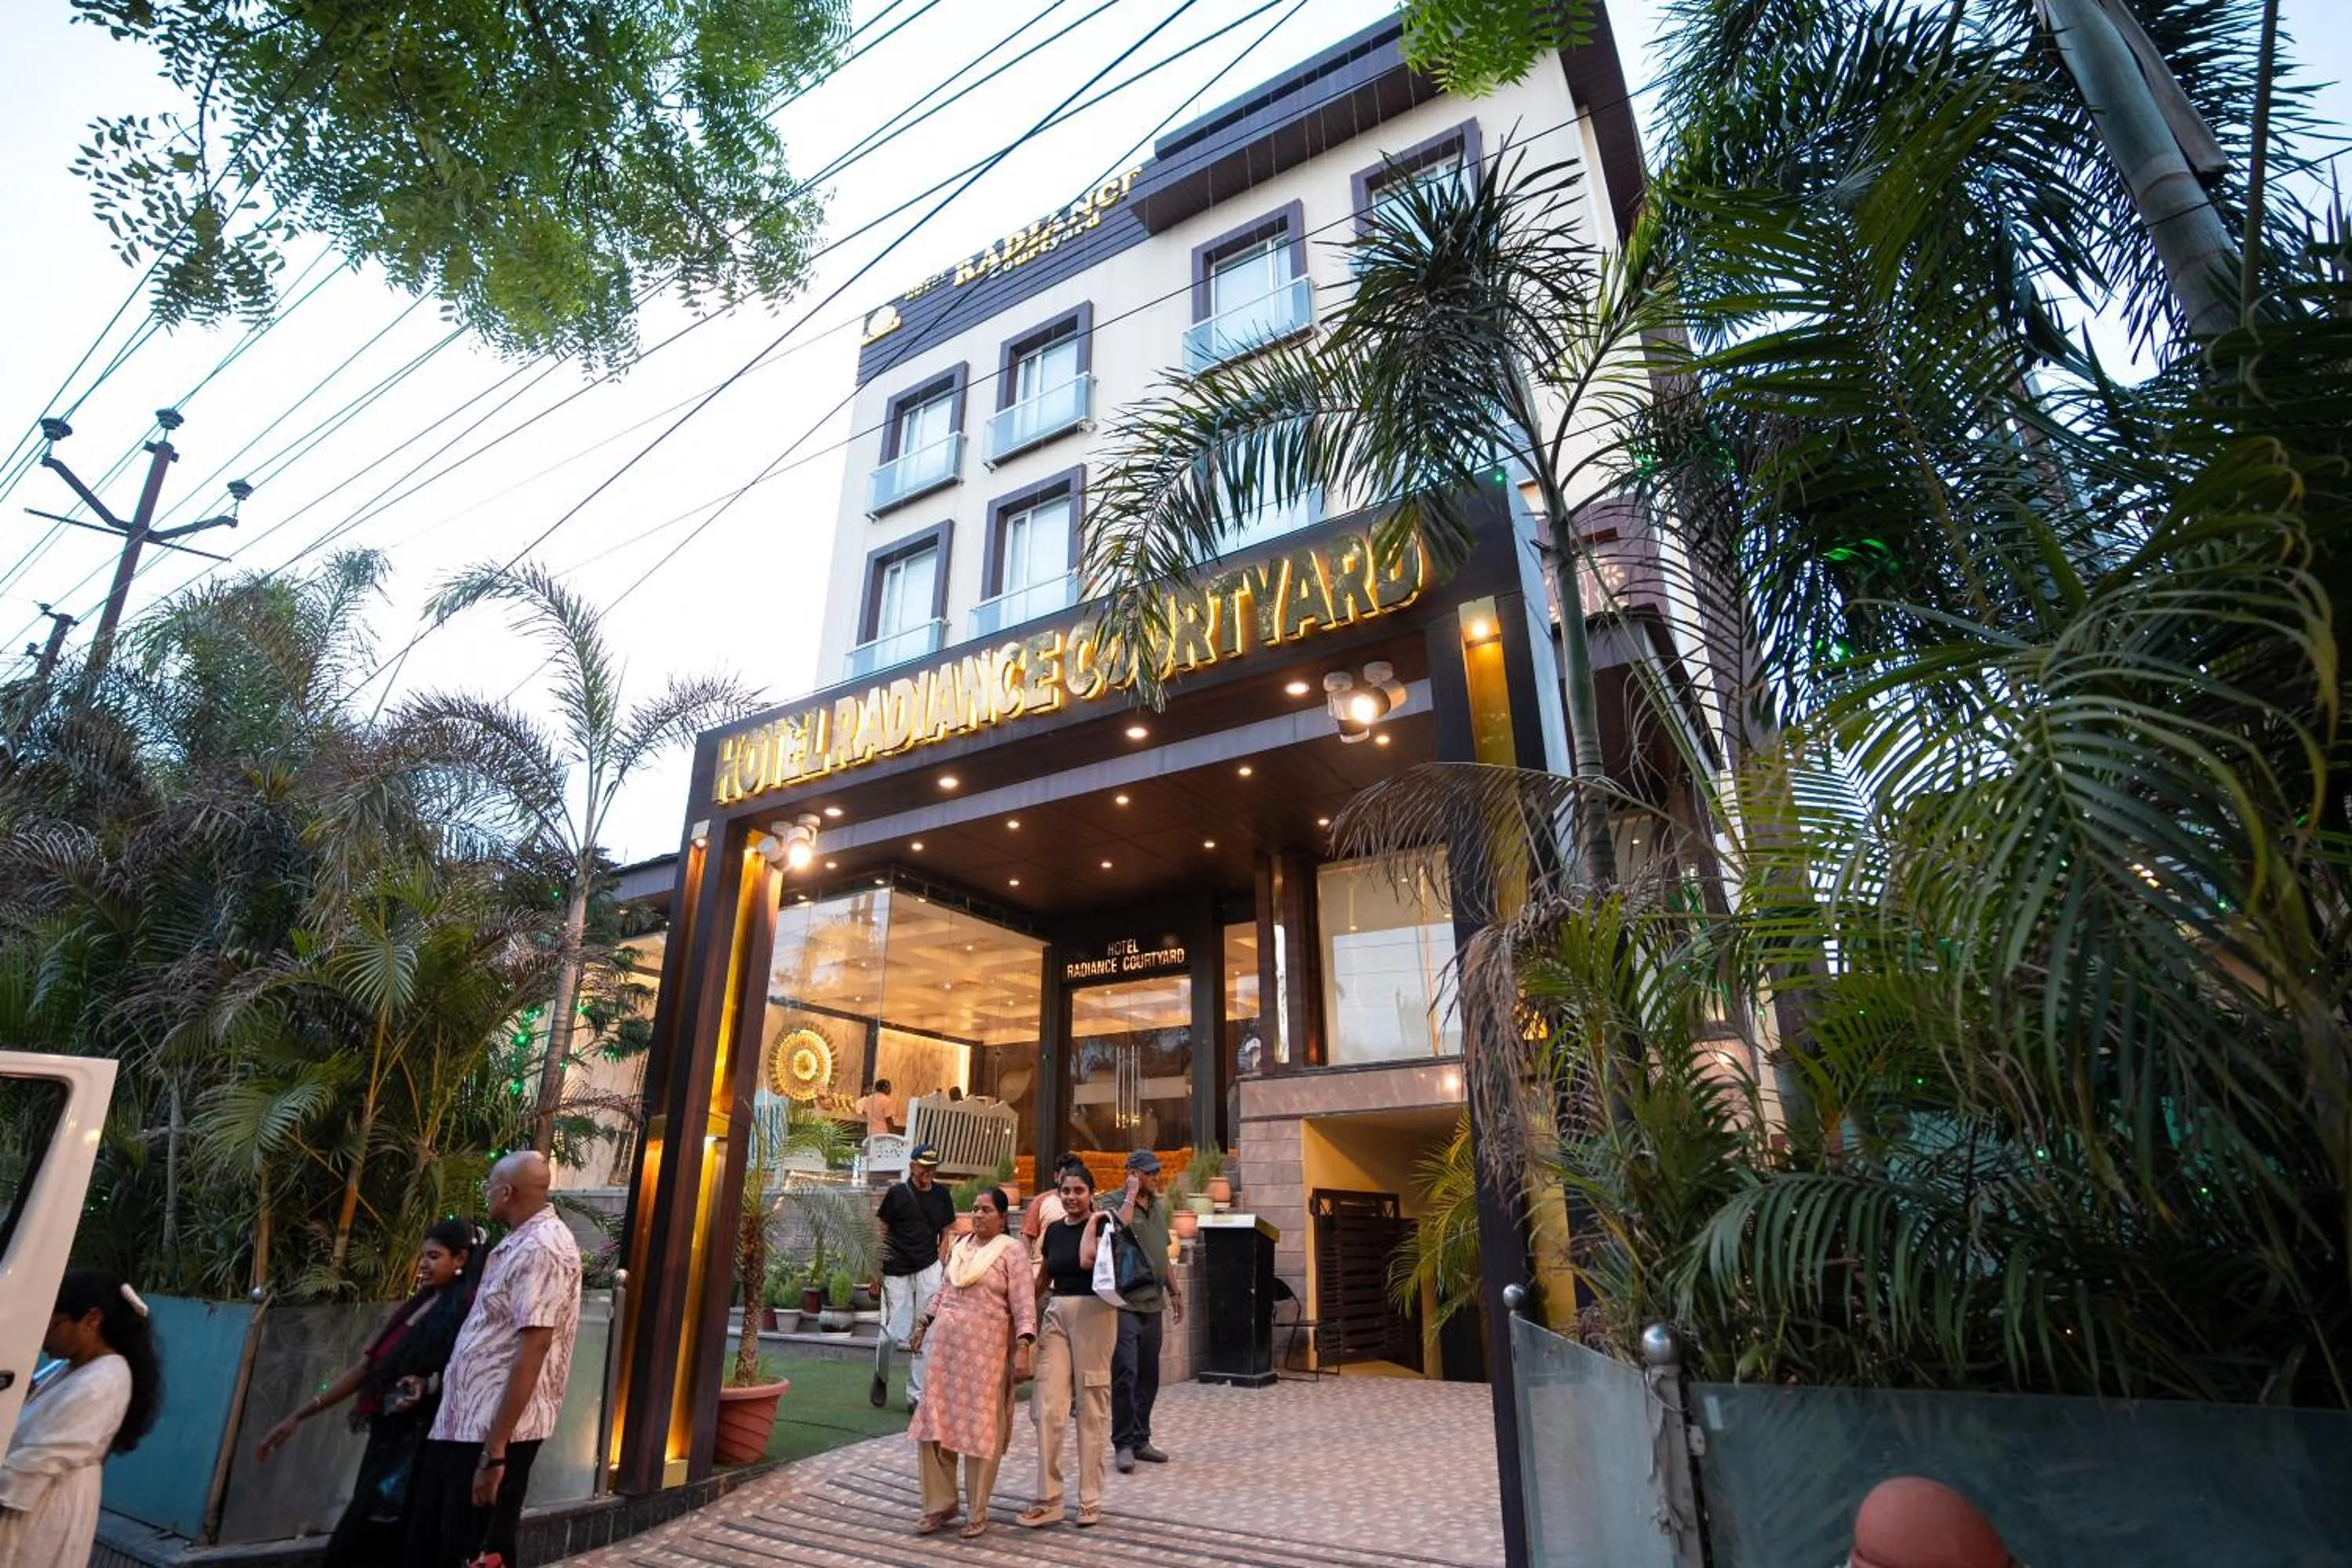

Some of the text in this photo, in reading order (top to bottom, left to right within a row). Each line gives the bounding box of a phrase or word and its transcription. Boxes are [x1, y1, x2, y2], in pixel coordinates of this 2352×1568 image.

[713, 706, 831, 804] HOTEL
[830, 630, 1065, 771] RADIANCE
[1107, 939, 1139, 956] HOTEL
[1067, 948, 1185, 978] RADIANCE COURTYARD
